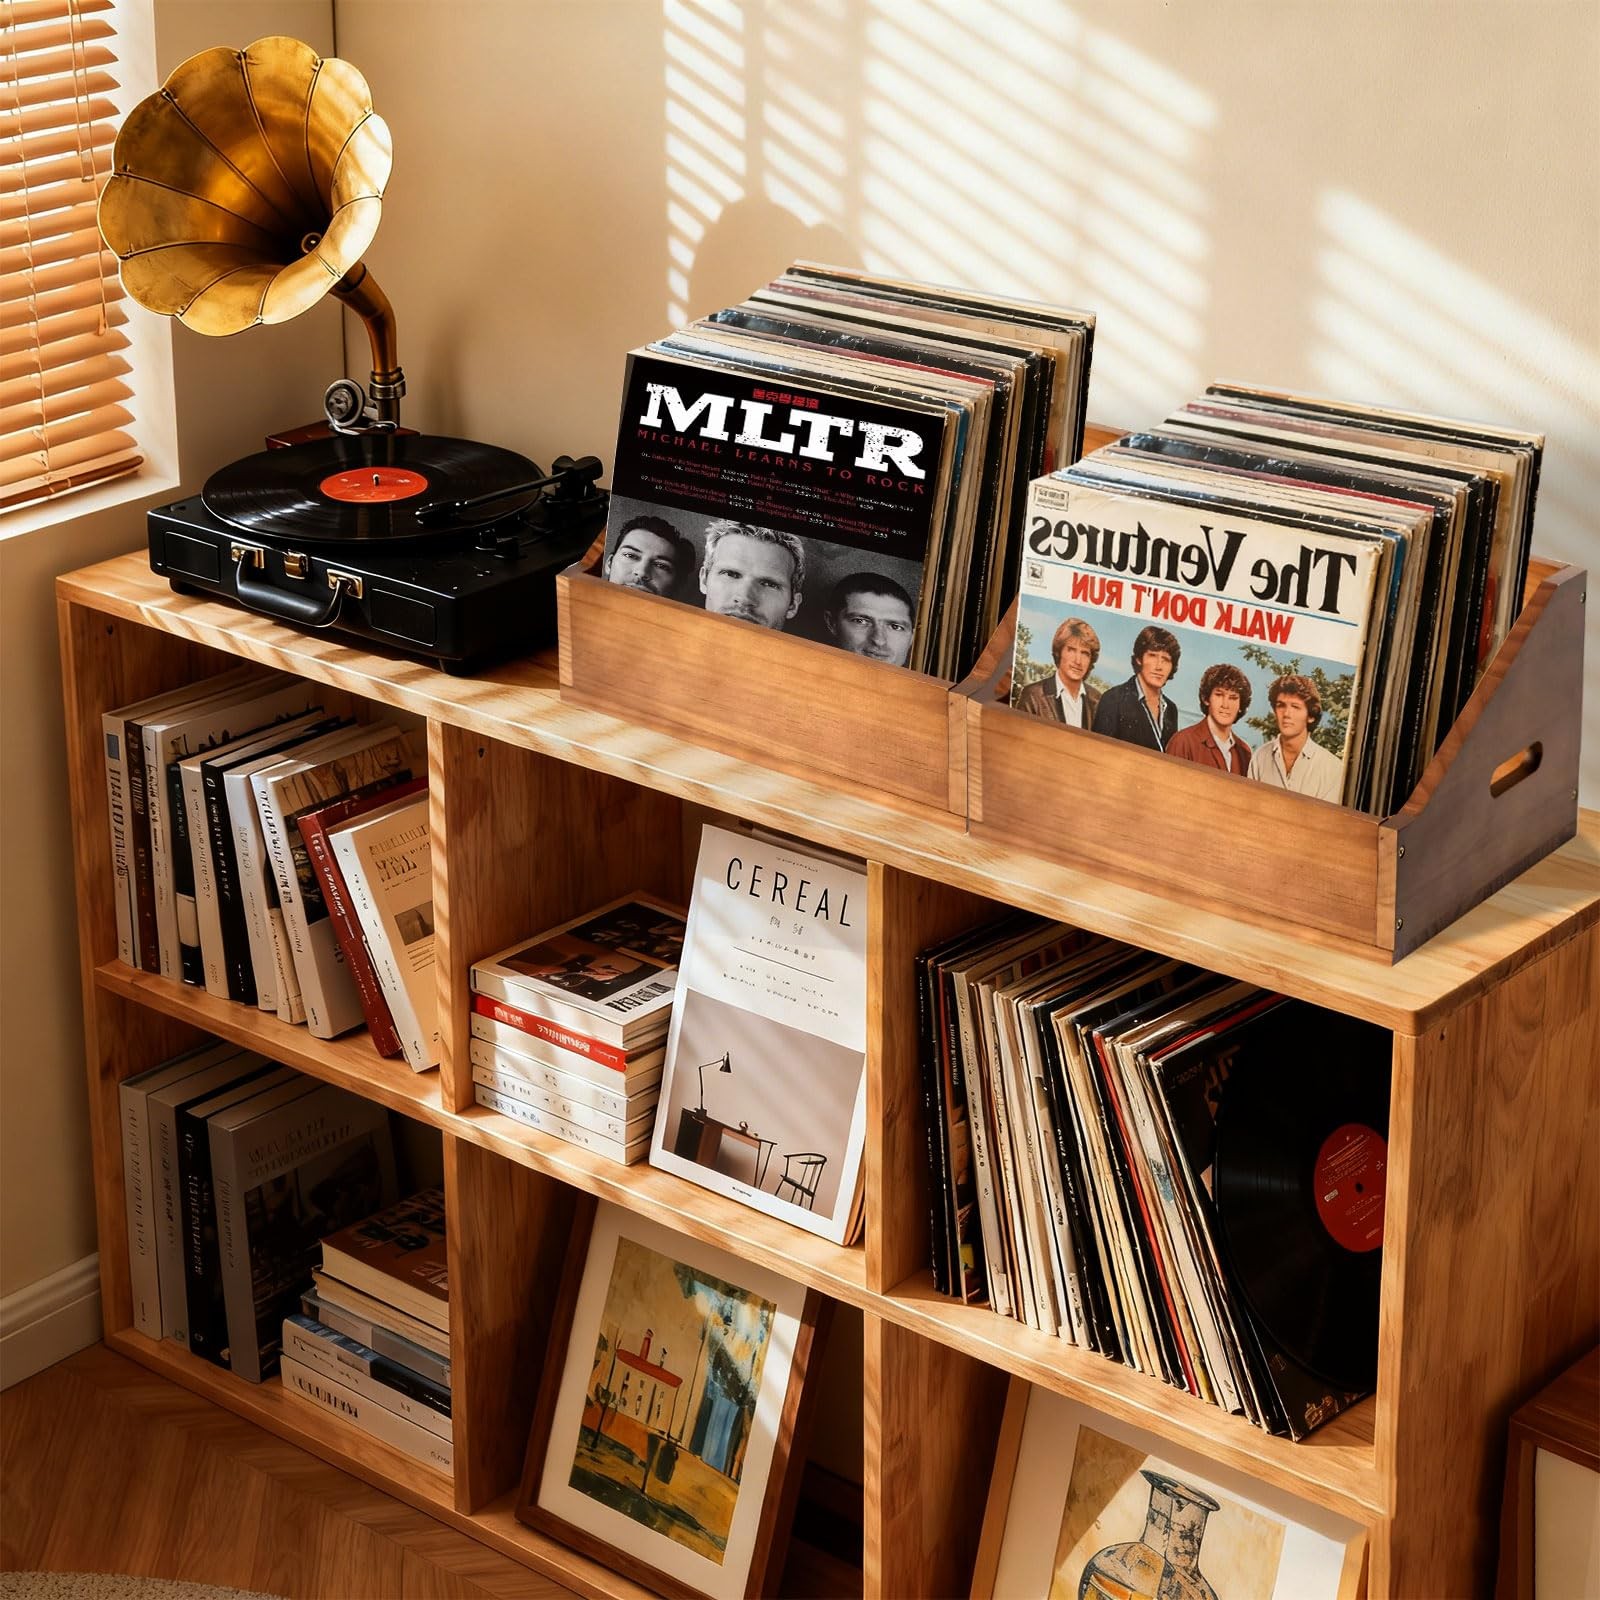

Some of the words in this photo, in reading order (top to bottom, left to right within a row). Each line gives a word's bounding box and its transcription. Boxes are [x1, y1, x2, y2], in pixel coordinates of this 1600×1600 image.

[638, 429, 722, 454] MICHAEL
[736, 447, 813, 474] LEARNS
[827, 467, 853, 481] TO
[867, 474, 926, 495] ROCK
[639, 382, 926, 480] MLTR
[726, 857, 851, 927] CEREAL
